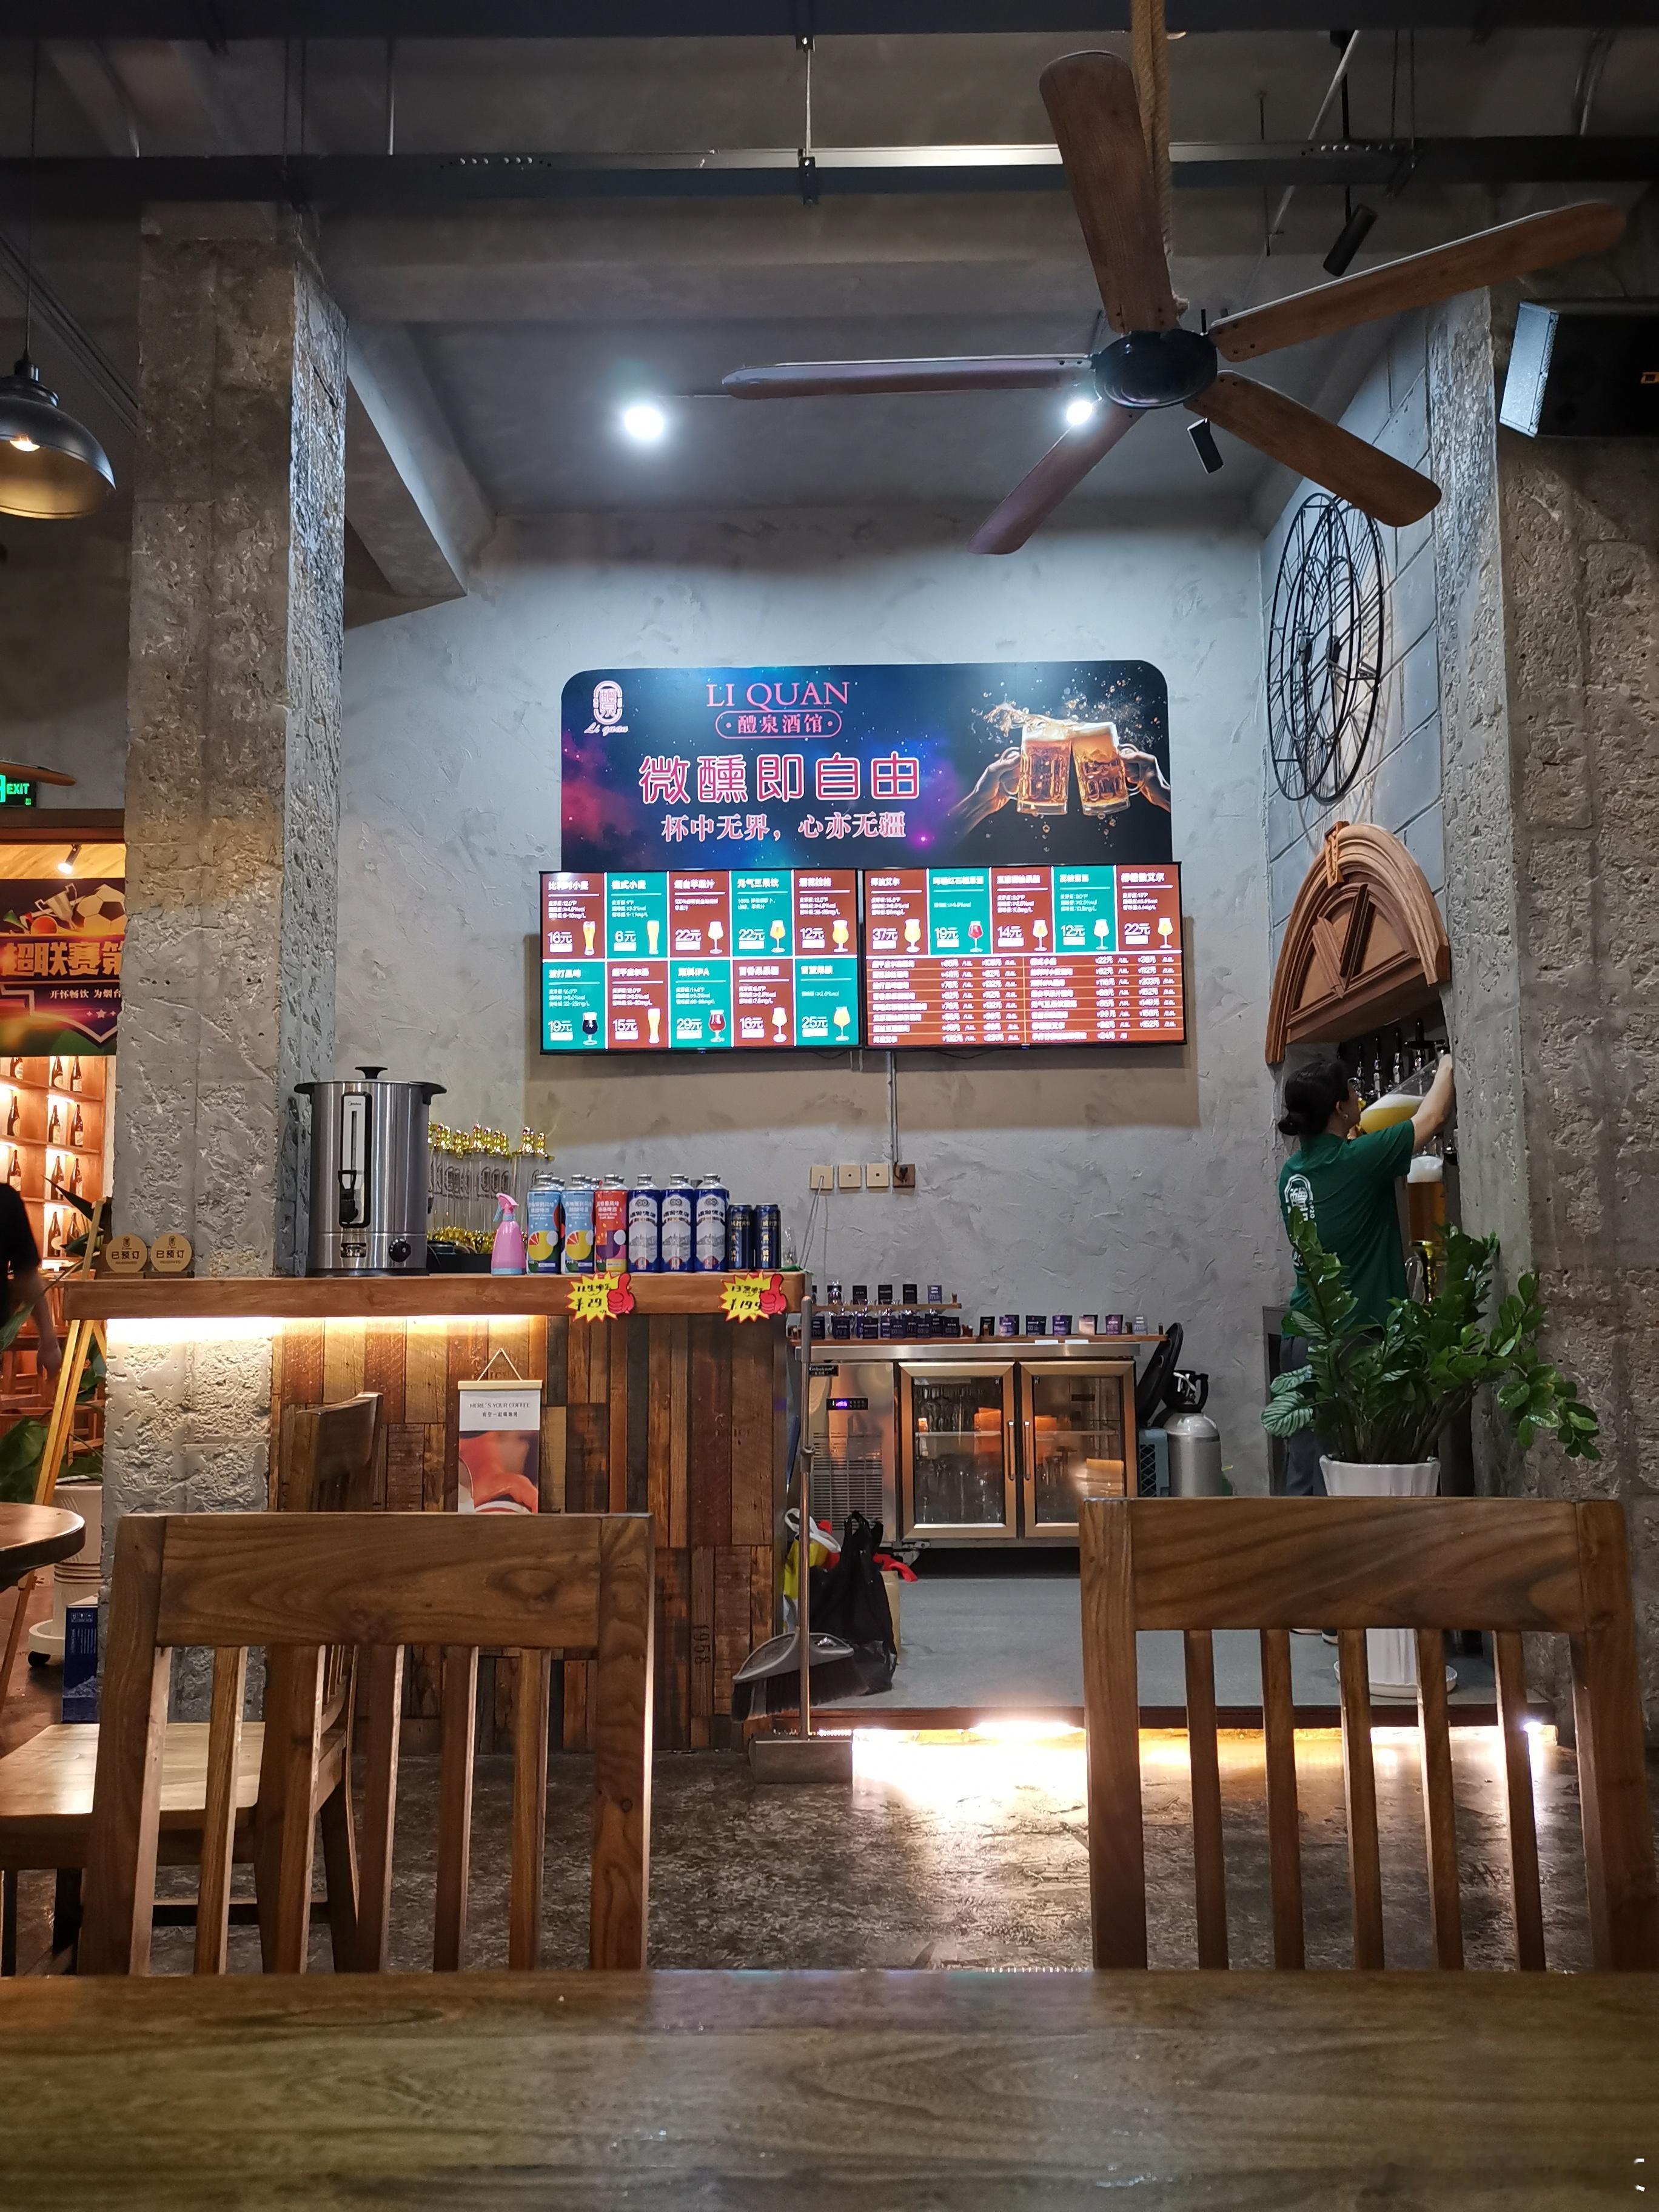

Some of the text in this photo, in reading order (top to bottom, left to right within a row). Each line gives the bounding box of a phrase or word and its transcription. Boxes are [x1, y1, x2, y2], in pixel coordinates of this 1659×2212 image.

[706, 682, 850, 711] LI QUAN
[737, 714, 823, 734] 醴泉酒馆
[638, 751, 920, 805] 微醺即自由
[7, 783, 30, 794] EXIT
[675, 929, 702, 942] 22元
[739, 928, 765, 940] 22元
[800, 927, 825, 940] 12元
[872, 928, 898, 940] 37元
[997, 925, 1022, 938] 14元
[1061, 924, 1085, 937] 12元
[1124, 923, 1151, 936] 22元
[50, 989, 90, 999] 开怀畅饮
[548, 1020, 572, 1033] 19元
[612, 1019, 638, 1031] 15元
[676, 1017, 703, 1030] 29元
[802, 1016, 828, 1028] 25元
[111, 1251, 140, 1259] 已预订
[156, 1250, 184, 1259] 已预订
[694, 1624, 710, 1666] 1958
